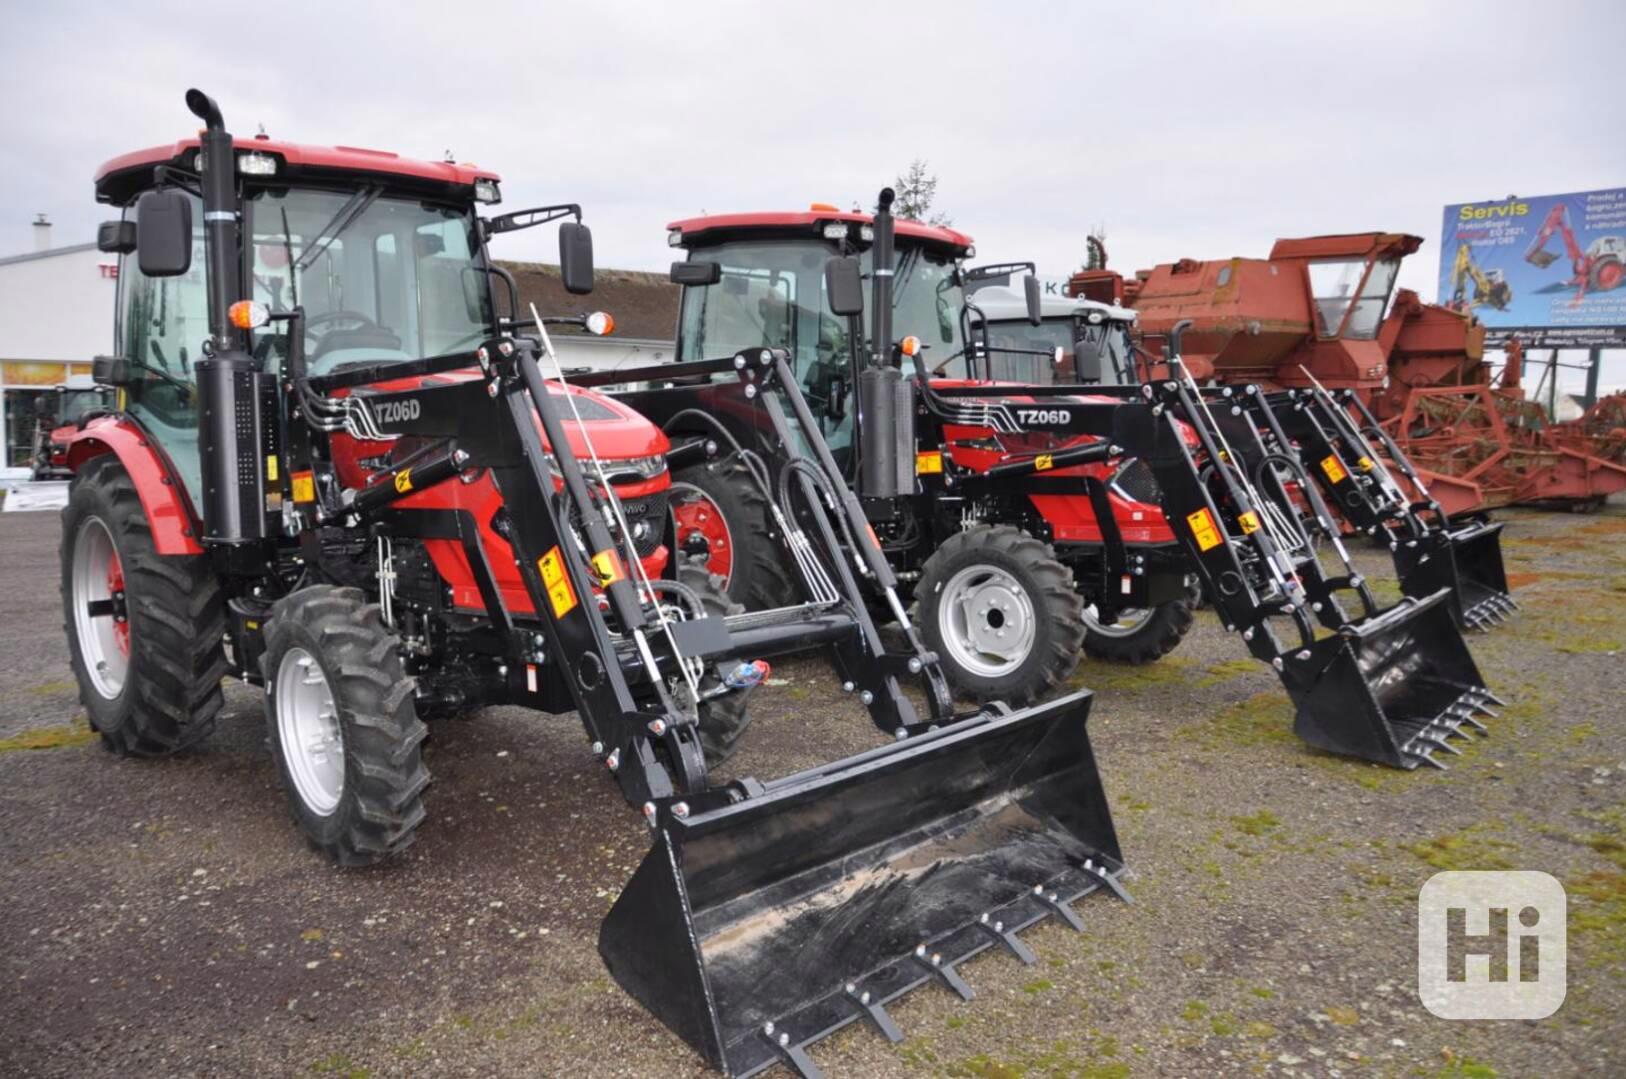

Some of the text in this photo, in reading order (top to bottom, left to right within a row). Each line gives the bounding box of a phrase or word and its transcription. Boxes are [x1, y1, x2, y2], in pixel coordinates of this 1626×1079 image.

[1459, 201, 1528, 220] Servis
[375, 399, 421, 424] TZ06D
[1017, 410, 1071, 425] TZ06D
